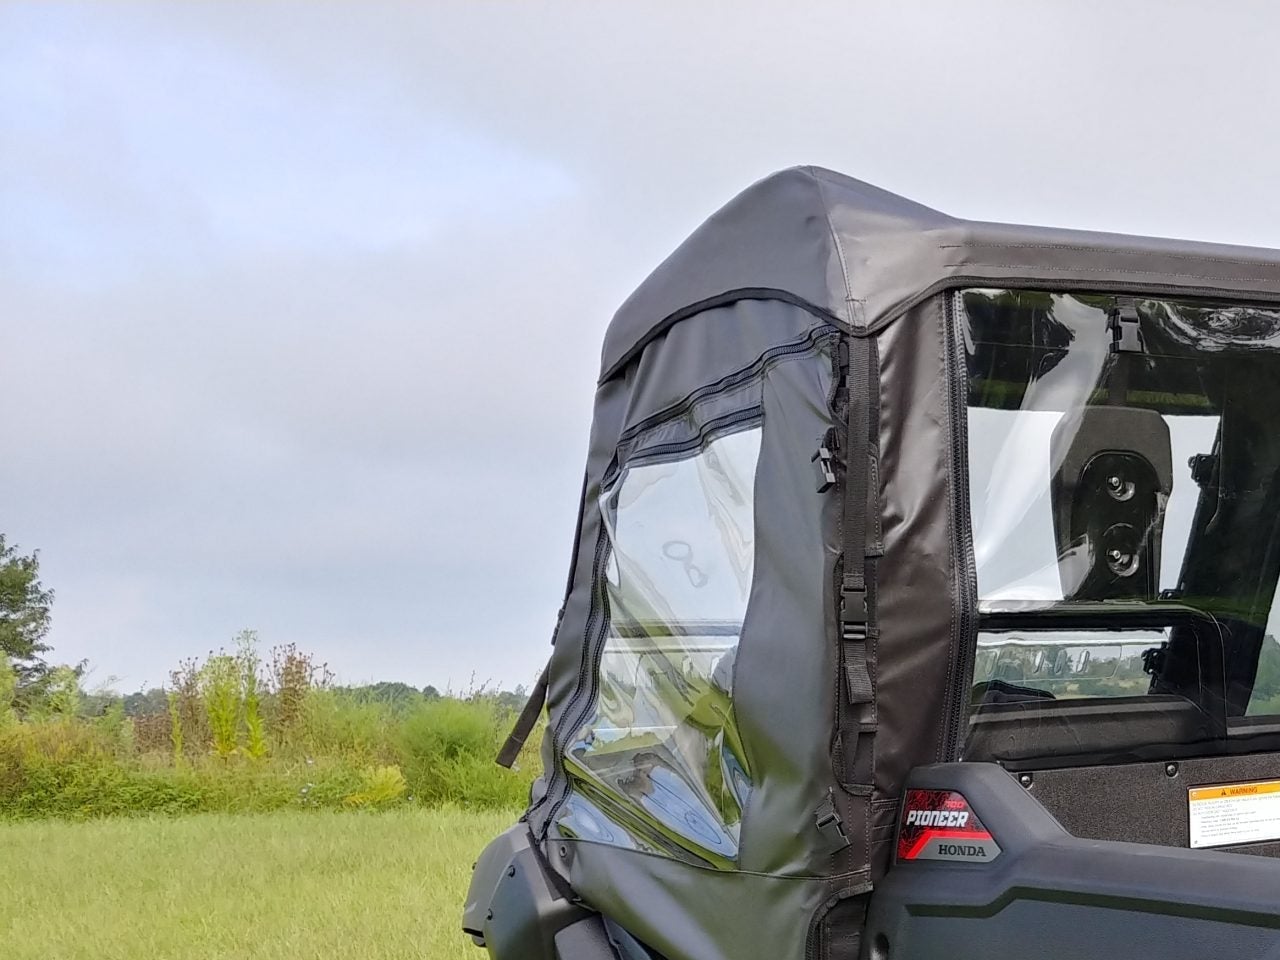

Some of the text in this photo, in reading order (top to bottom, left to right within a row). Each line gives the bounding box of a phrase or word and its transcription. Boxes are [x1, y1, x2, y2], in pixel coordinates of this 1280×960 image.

[1230, 786, 1258, 795] WARNING
[906, 810, 969, 827] PIONEER
[938, 844, 987, 857] HONDA
